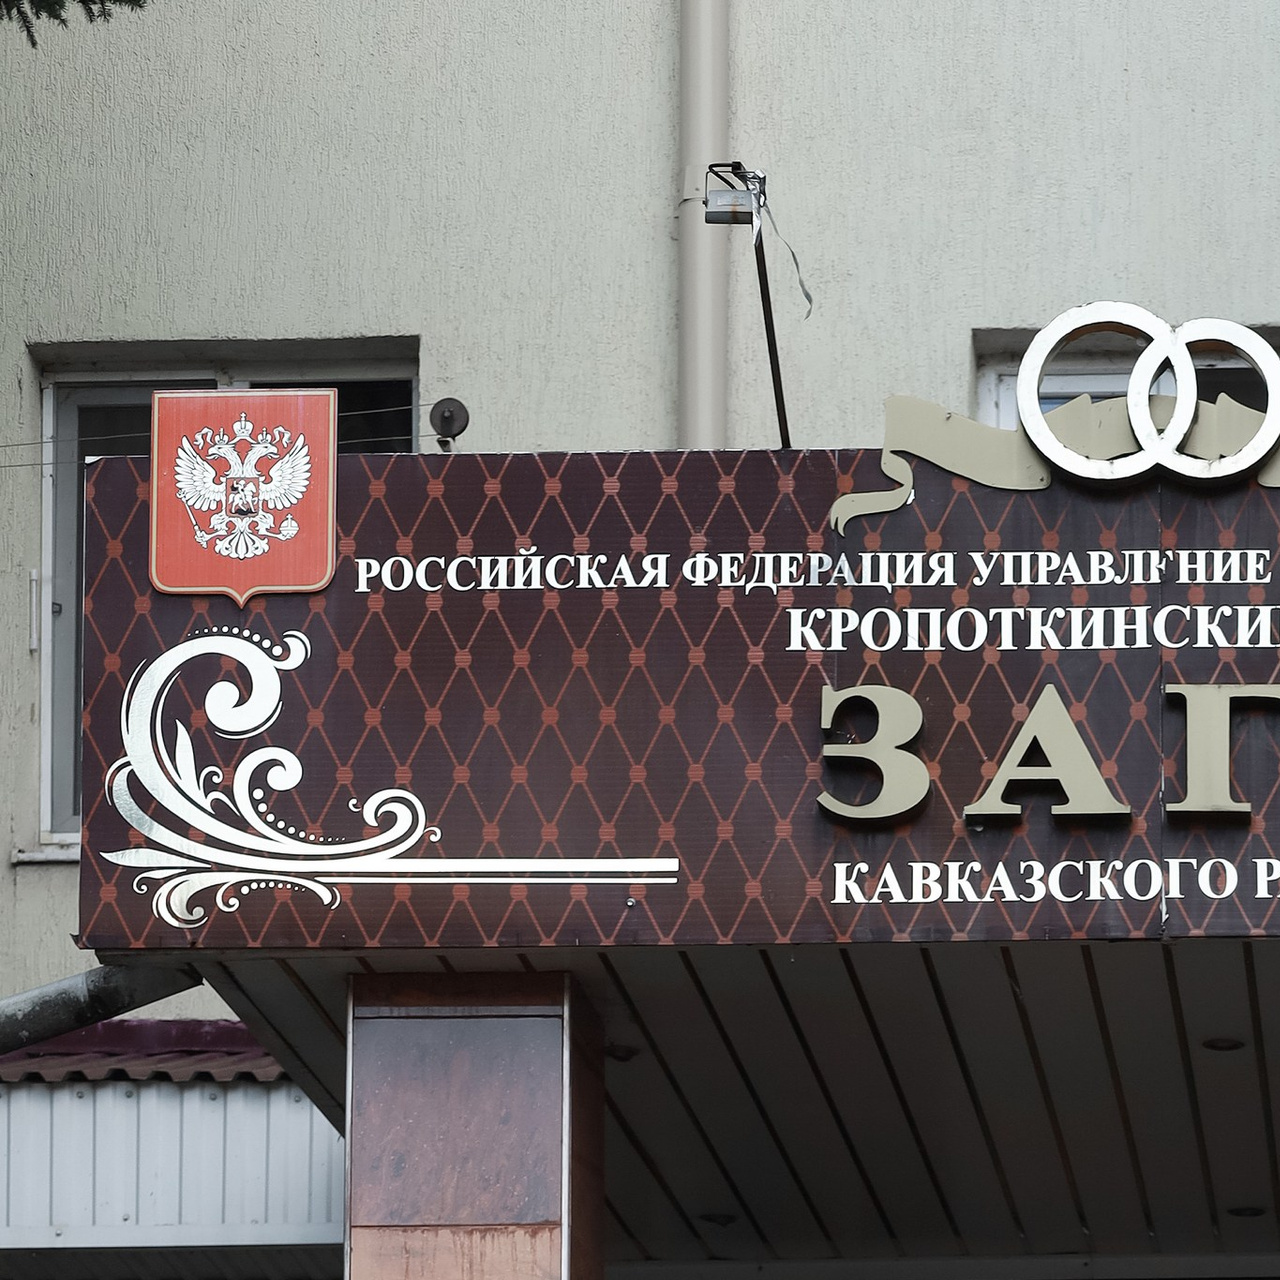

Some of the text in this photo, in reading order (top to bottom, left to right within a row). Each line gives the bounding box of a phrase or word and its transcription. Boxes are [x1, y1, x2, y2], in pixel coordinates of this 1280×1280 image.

[354, 545, 671, 593] РОССИЙСКАЯ
[681, 550, 958, 595] ФЕДЕРАЦИЯ
[830, 855, 1239, 904] КАВКАЗСКОГО
